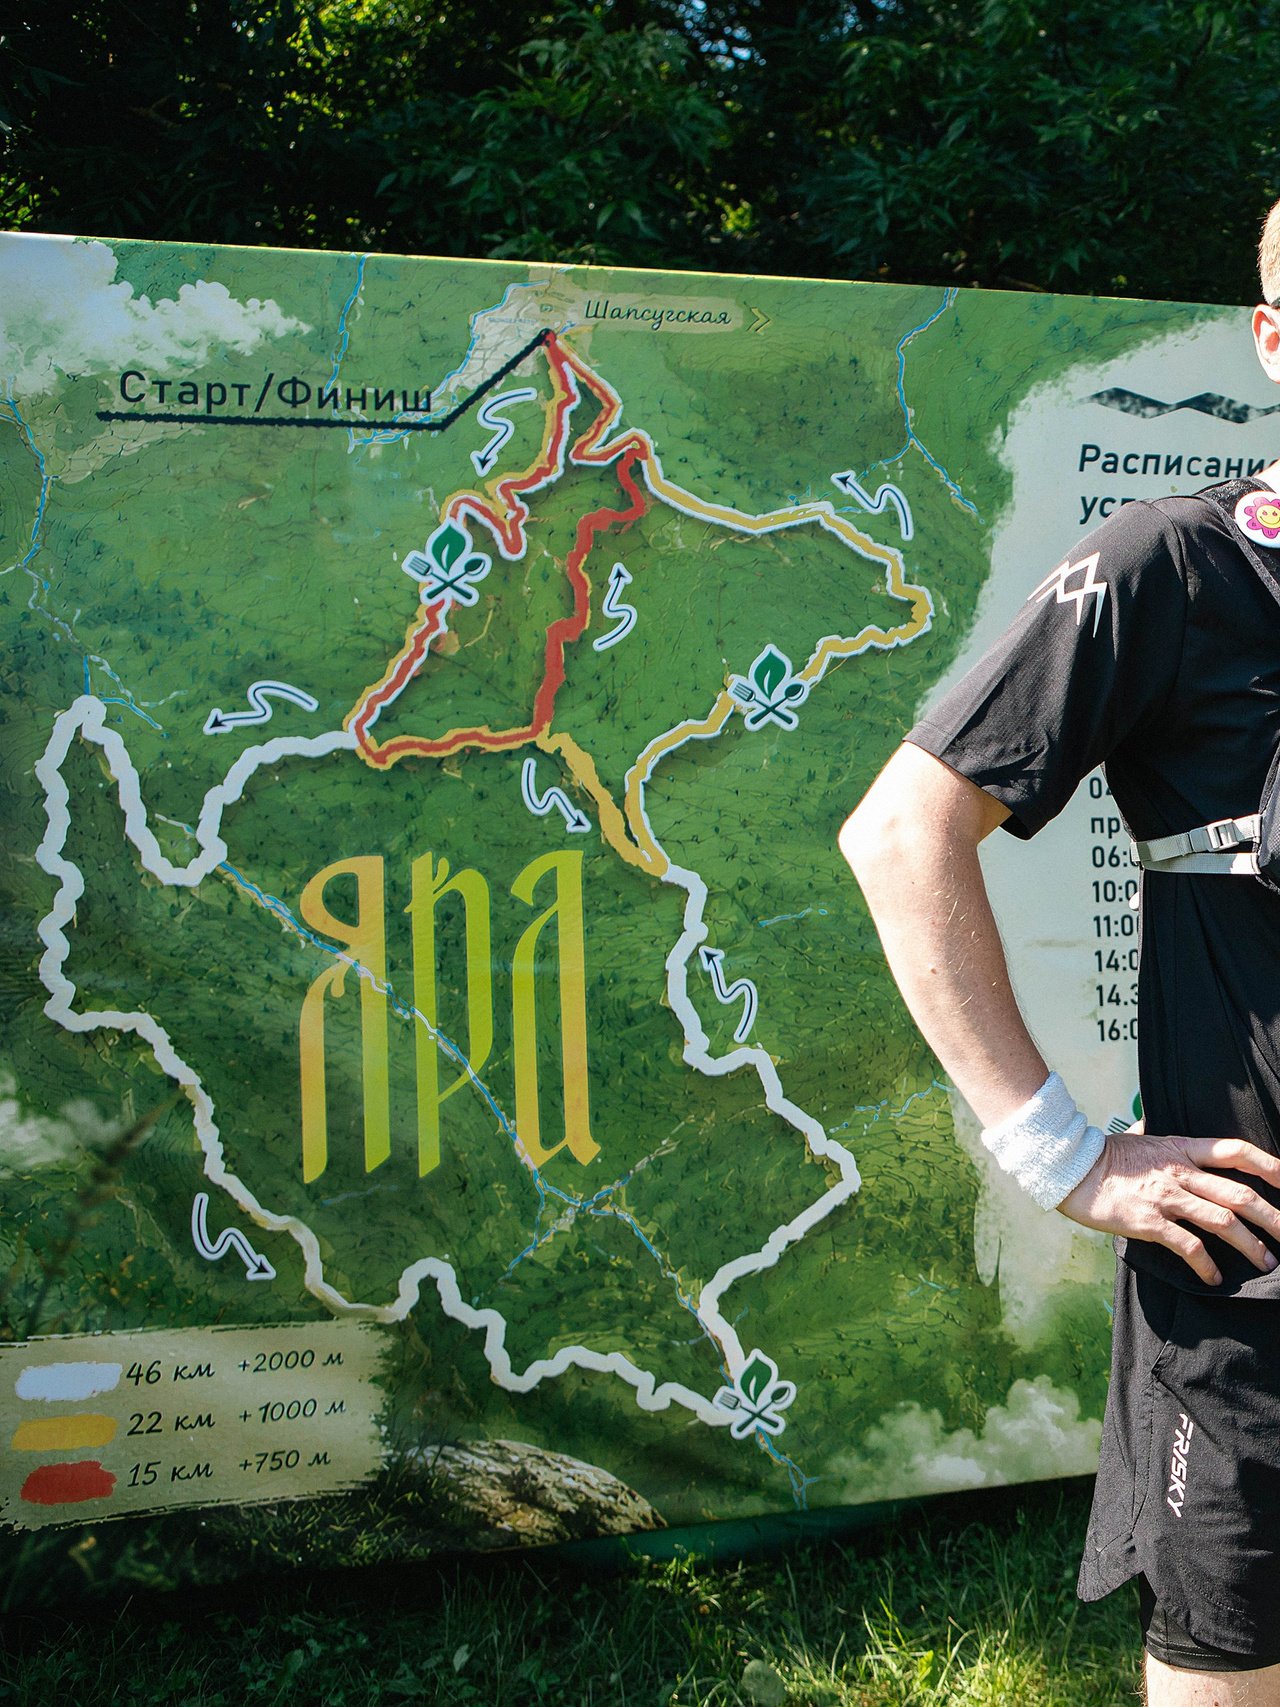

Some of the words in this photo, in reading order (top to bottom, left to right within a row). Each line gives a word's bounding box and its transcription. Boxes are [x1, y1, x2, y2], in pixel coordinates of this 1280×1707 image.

[584, 299, 732, 331] Шапсугская
[120, 370, 432, 413] Старт/Финиш
[1092, 845, 1139, 868] 06:
[1092, 879, 1138, 903] 10:0
[1093, 914, 1139, 938] 11:0
[1094, 948, 1138, 972] 14:0
[1096, 983, 1138, 1006] 14.3
[1097, 1018, 1138, 1041] 16:0
[126, 1360, 162, 1386] 46
[173, 1362, 215, 1381] км
[238, 1349, 315, 1373] +2000
[321, 1351, 344, 1367] м
[126, 1411, 163, 1436] 22
[174, 1413, 215, 1431] км
[325, 1400, 346, 1415] м
[127, 1461, 161, 1487] 15
[171, 1462, 213, 1482] км
[239, 1449, 300, 1473] +750
[307, 1451, 331, 1467] м
[1167, 1413, 1194, 1518] FRISKY
